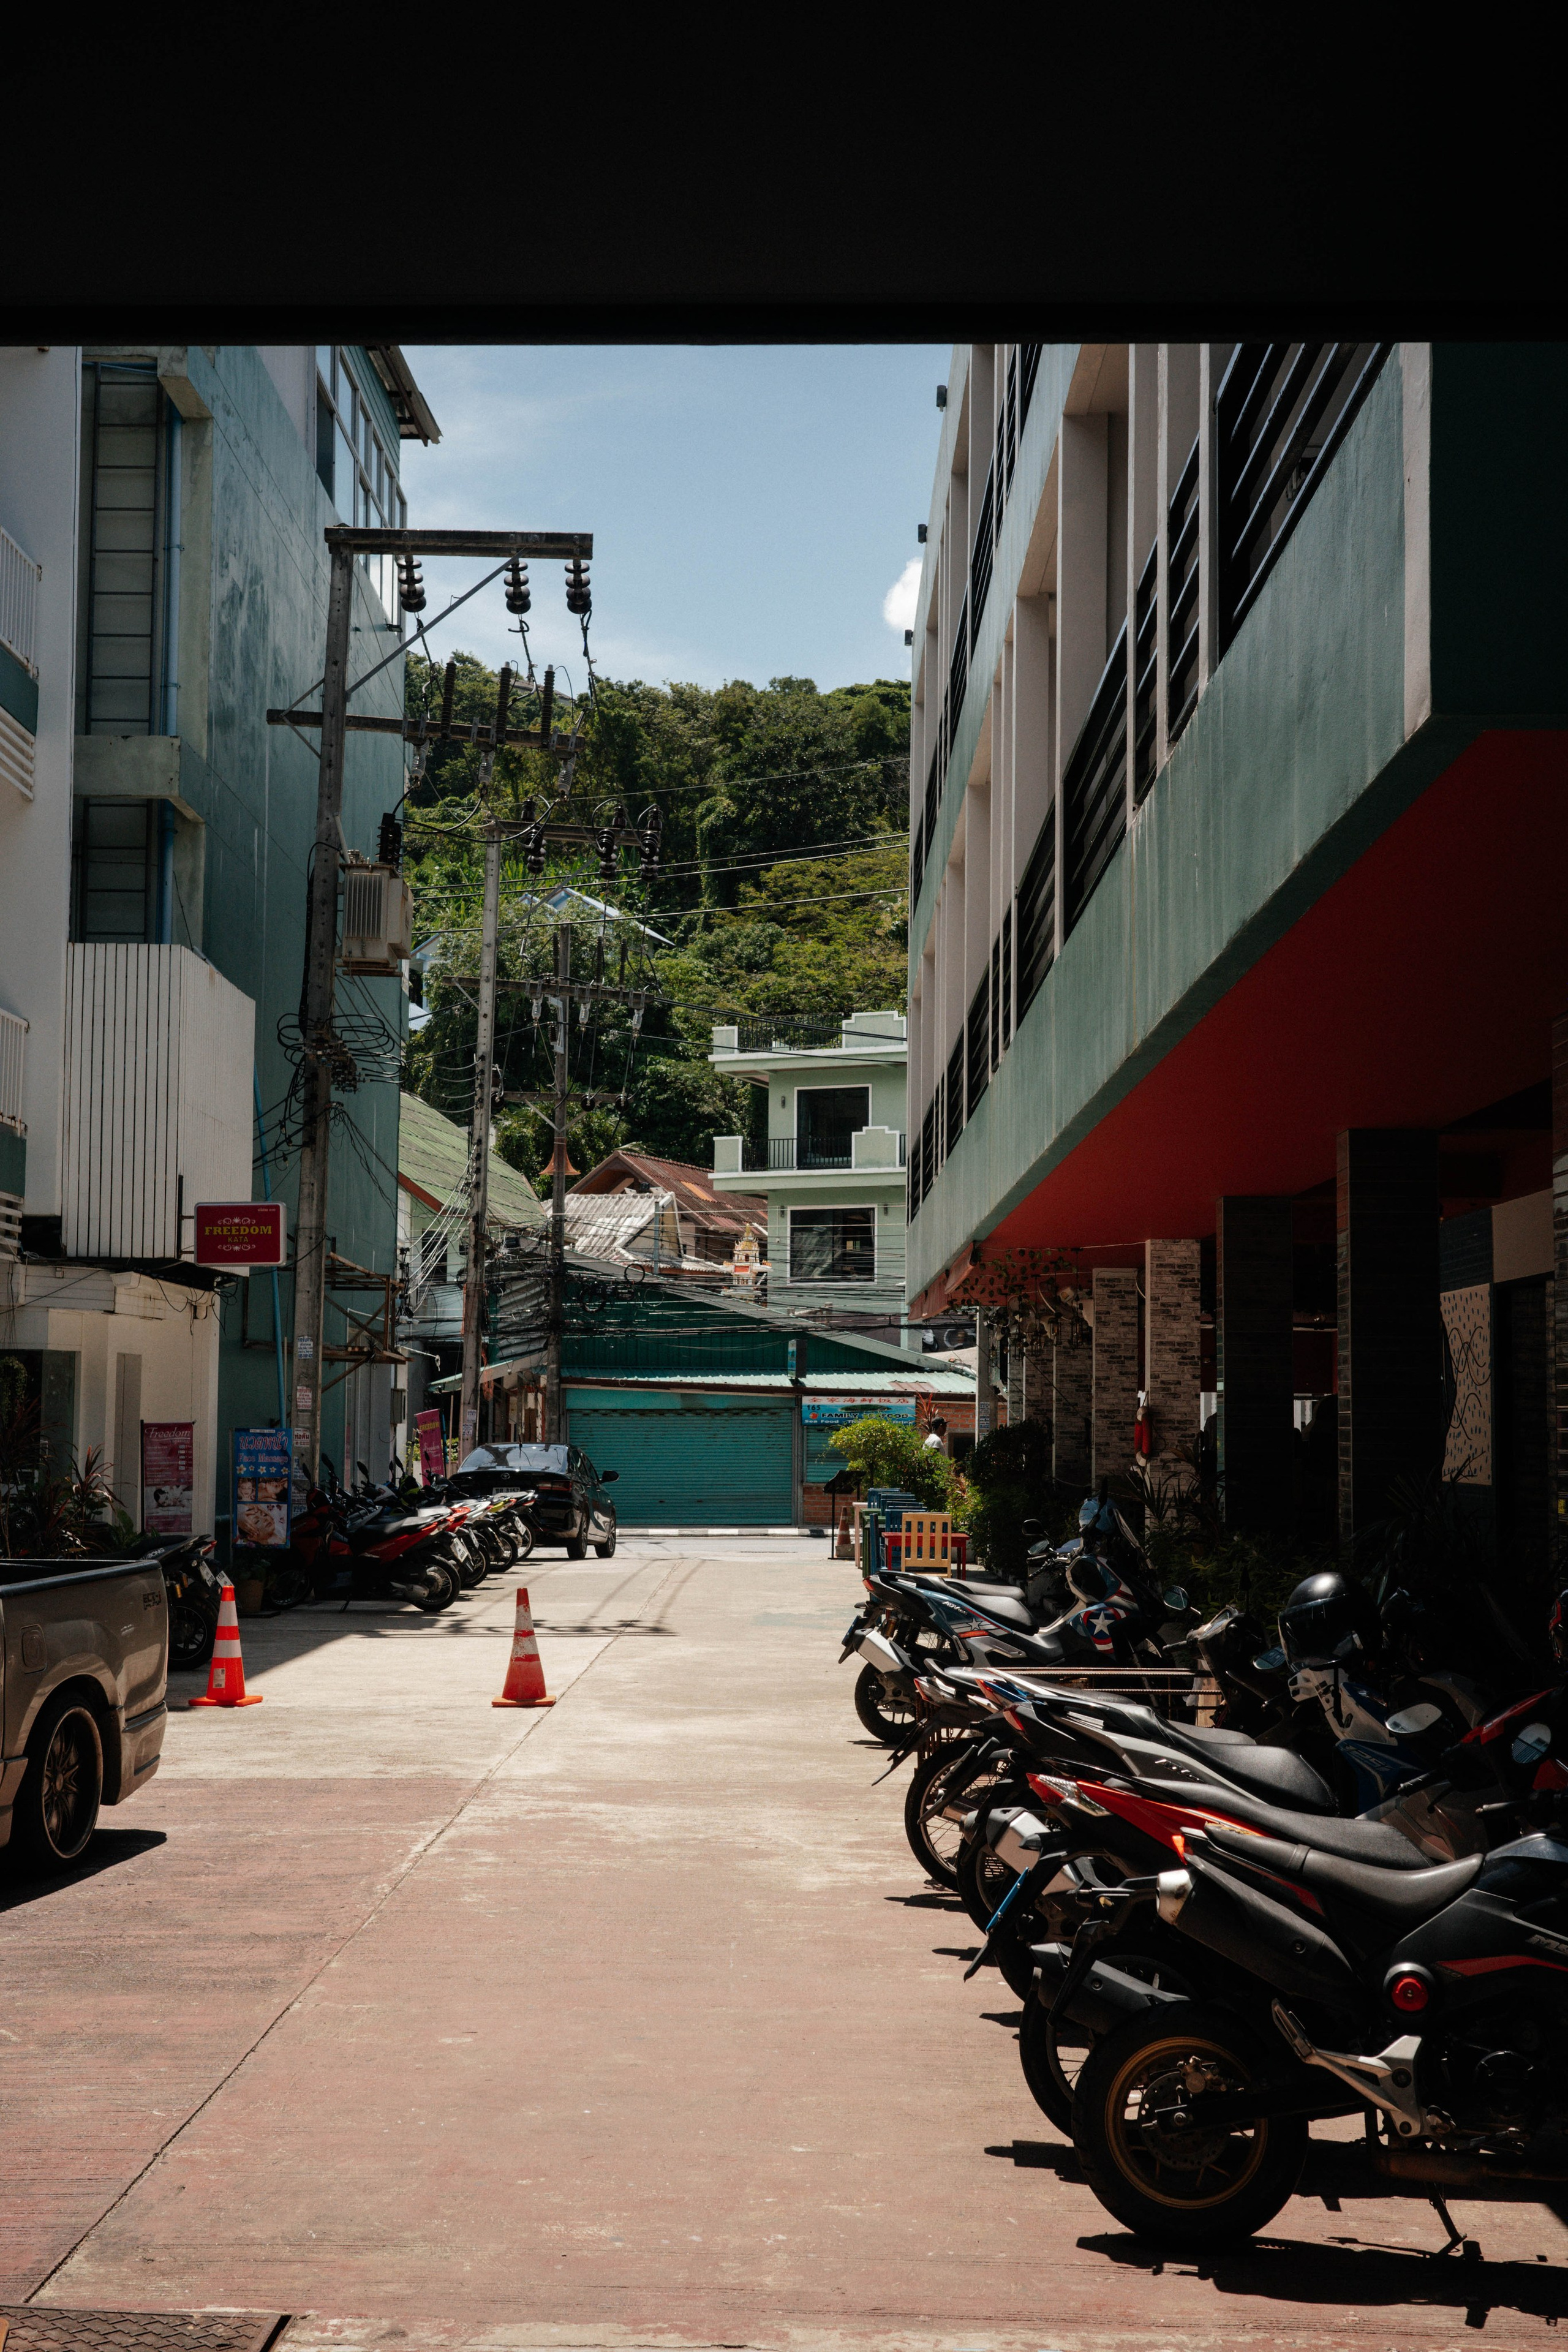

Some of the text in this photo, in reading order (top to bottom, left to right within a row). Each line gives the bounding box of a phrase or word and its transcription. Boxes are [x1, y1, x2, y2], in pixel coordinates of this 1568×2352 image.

[205, 1226, 272, 1235] FREEDOM
[145, 1427, 190, 1438] Freedom
[239, 1431, 288, 1450] นวดหน้า
[238, 1453, 288, 1464] Face Massage
